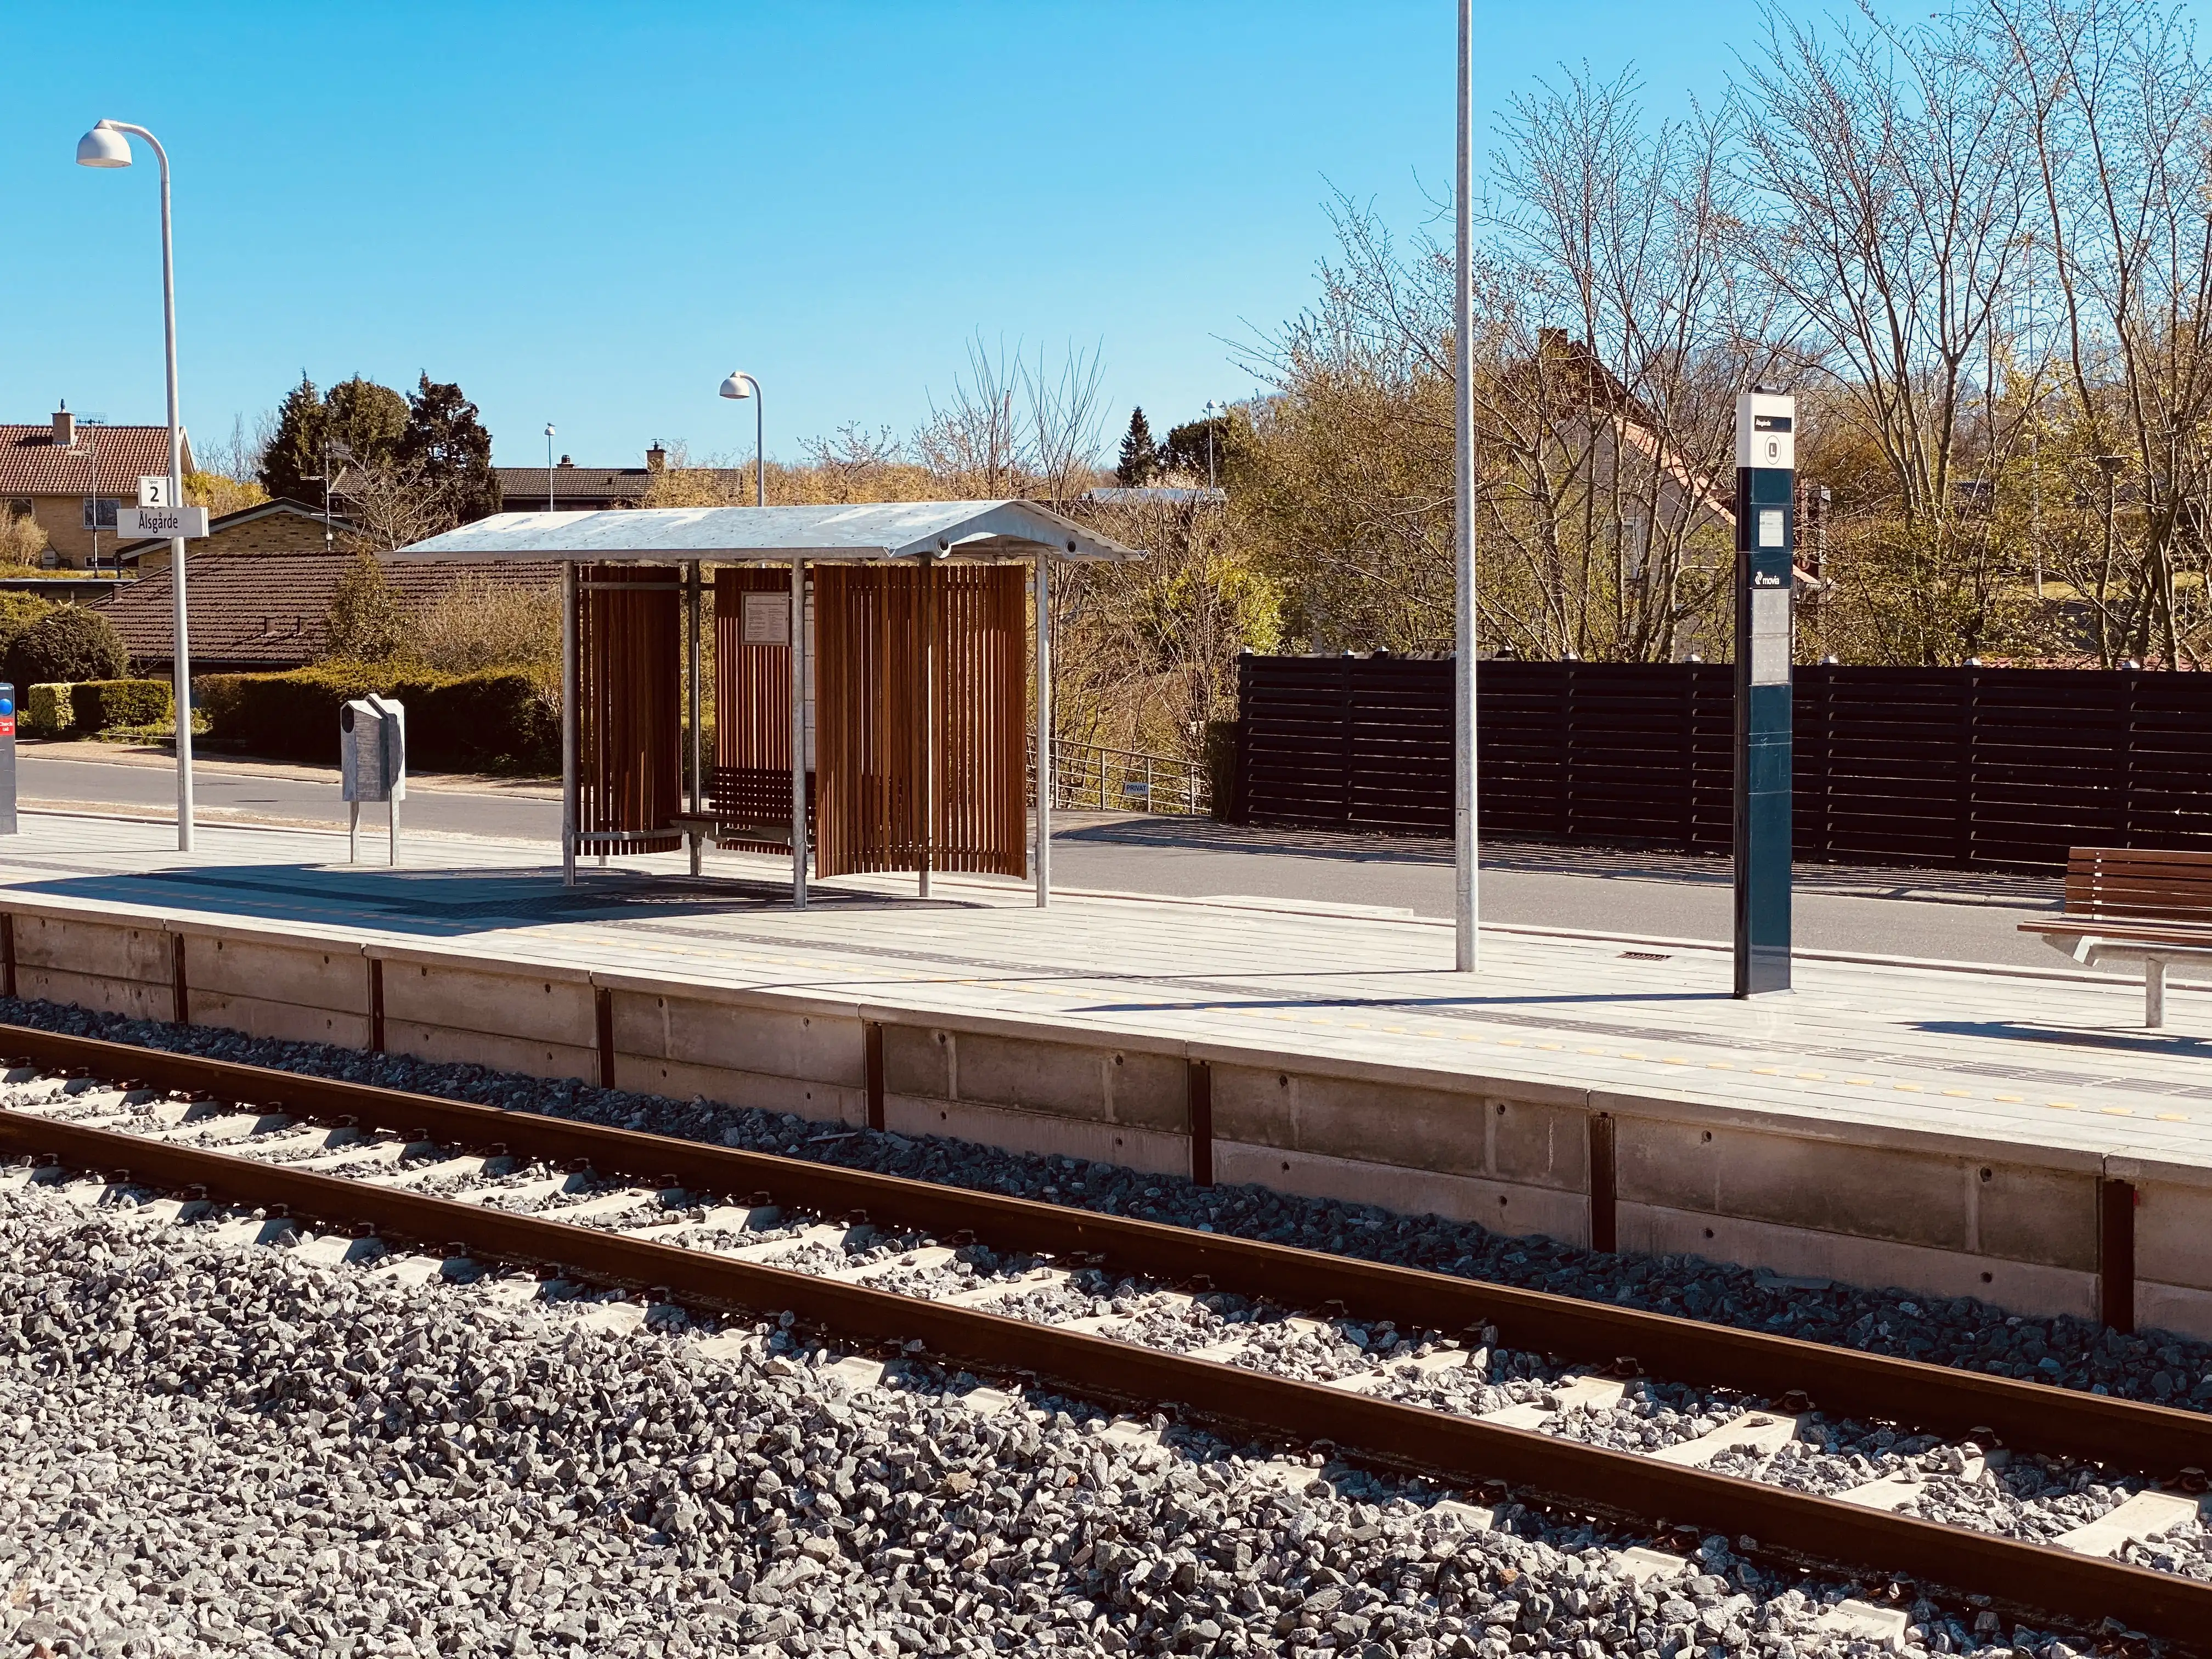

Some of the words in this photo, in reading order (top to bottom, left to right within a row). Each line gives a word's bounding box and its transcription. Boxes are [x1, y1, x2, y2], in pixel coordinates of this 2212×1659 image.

[1770, 445, 1775, 455] L
[150, 486, 159, 502] 2
[138, 510, 178, 534] Ålsgårde
[1762, 575, 1780, 585] movia
